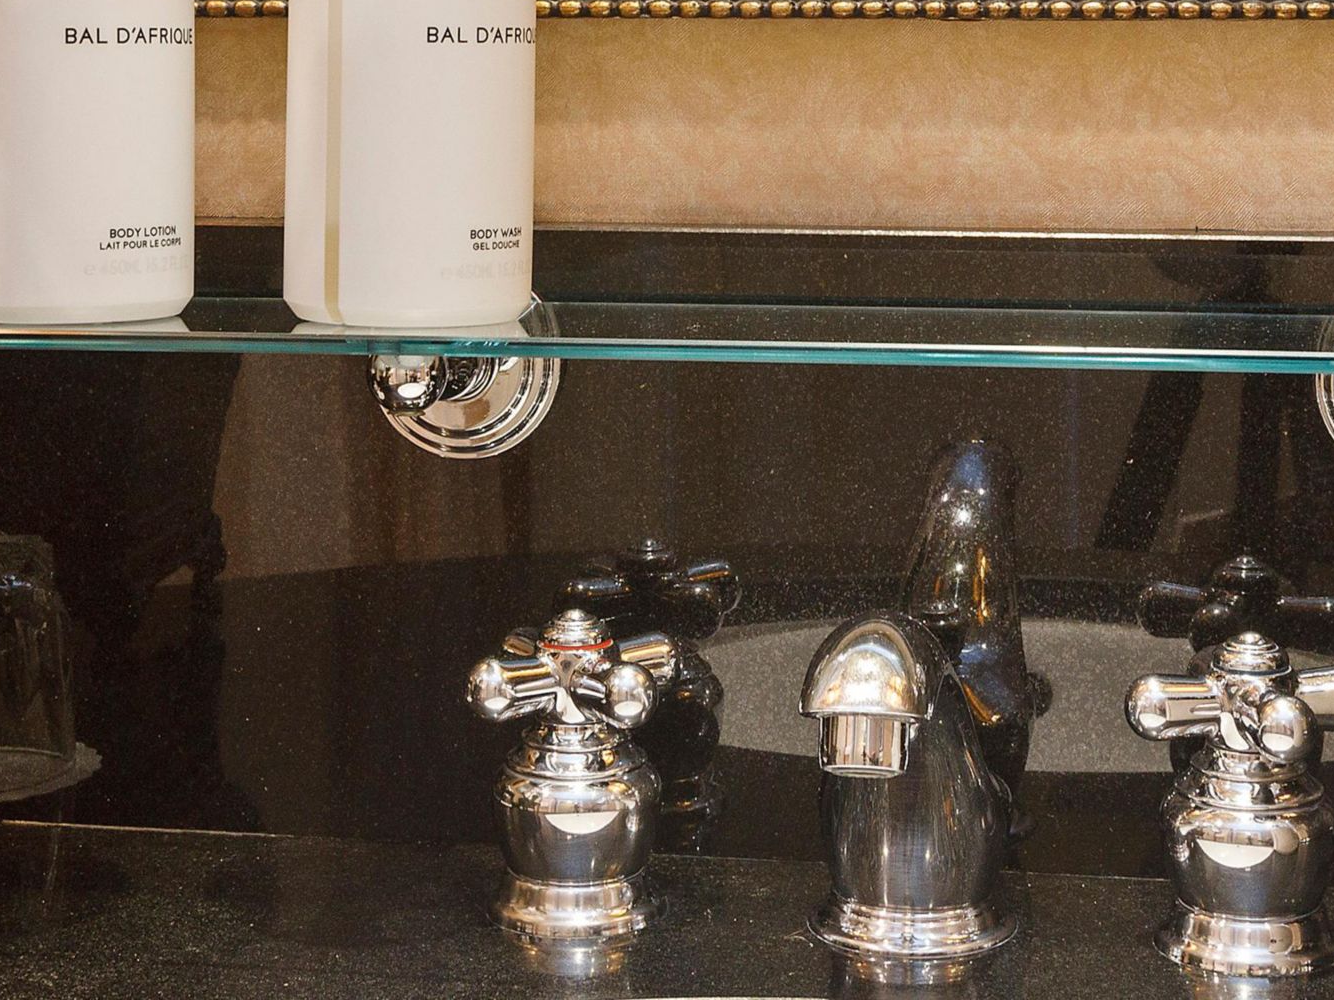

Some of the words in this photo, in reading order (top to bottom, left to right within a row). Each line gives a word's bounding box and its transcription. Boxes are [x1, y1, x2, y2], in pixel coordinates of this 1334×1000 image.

[64, 26, 109, 45] BAL
[116, 26, 193, 45] D'AFRIQUE
[426, 26, 469, 44] BAL
[109, 227, 142, 239] BODY
[144, 225, 177, 238] LOTION
[470, 229, 499, 240] BODY
[501, 226, 522, 238] WASH
[99, 241, 121, 251] LAIT
[123, 239, 148, 250] POUR
[149, 239, 159, 249] LE
[160, 237, 182, 248] CORPS
[472, 242, 490, 251] GEL
[492, 239, 520, 250] DOUCHE
